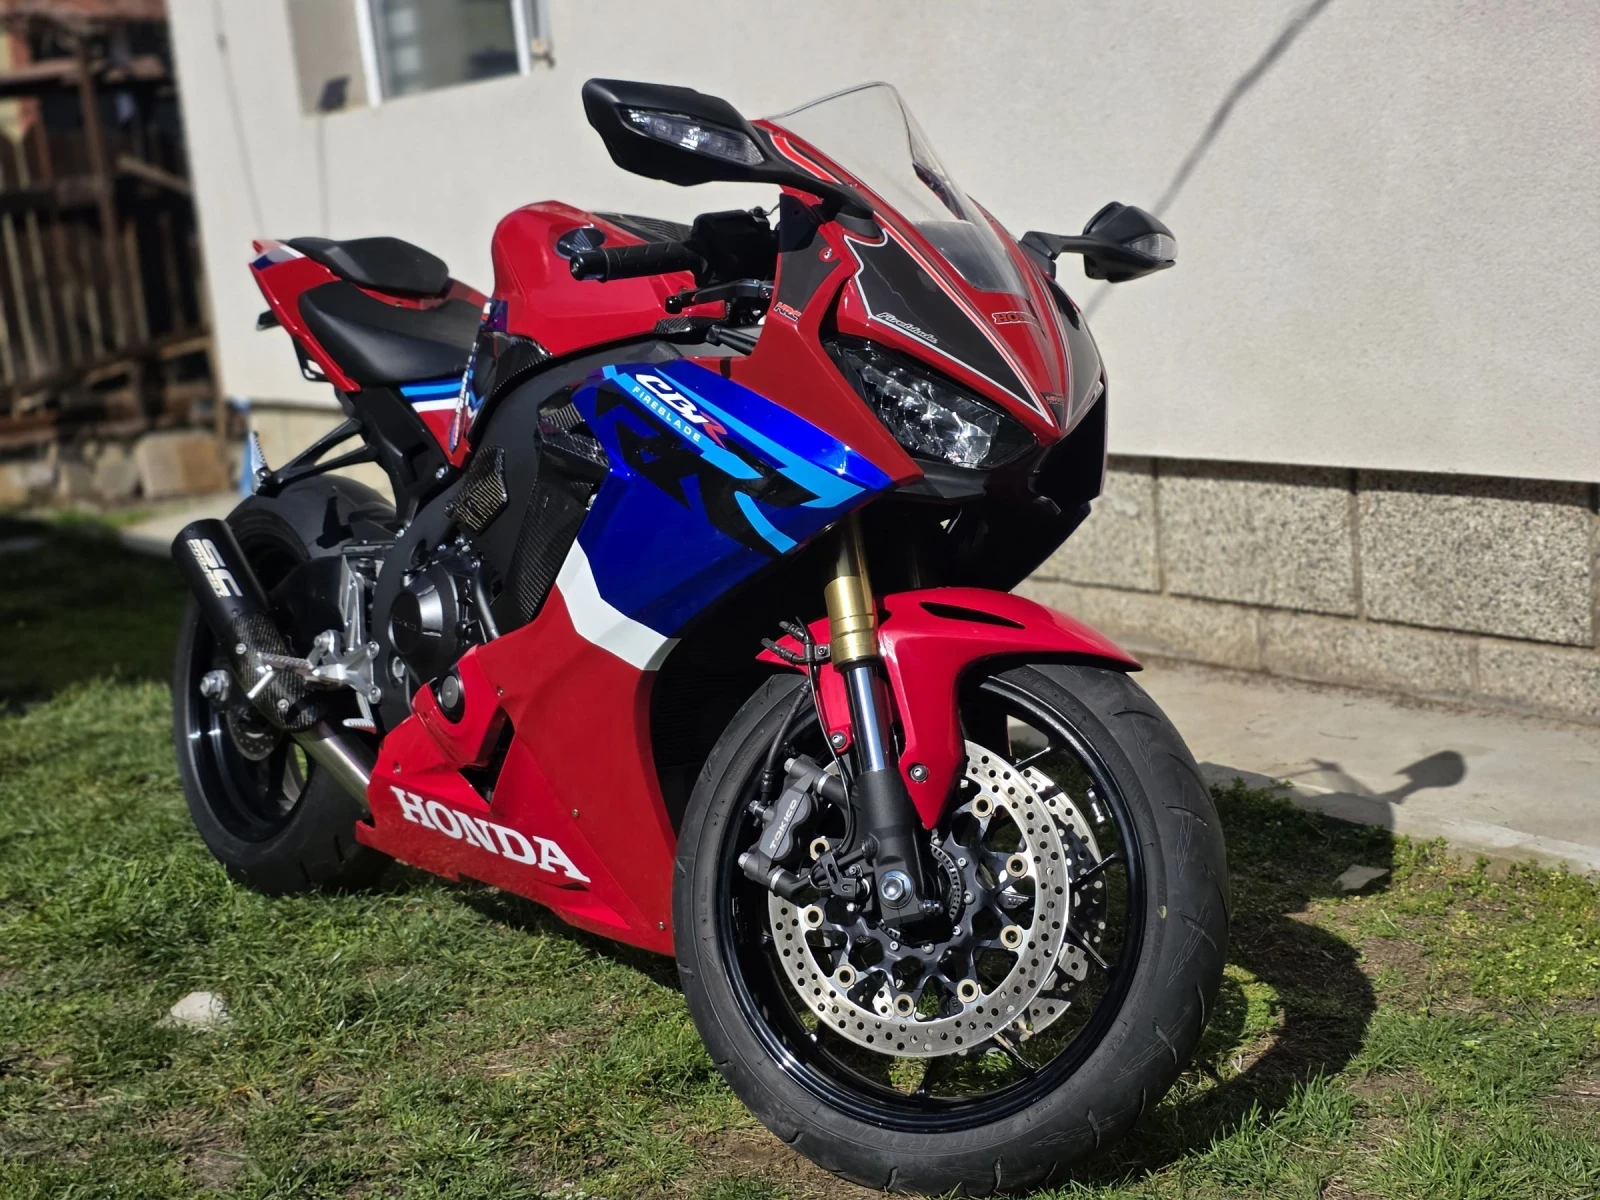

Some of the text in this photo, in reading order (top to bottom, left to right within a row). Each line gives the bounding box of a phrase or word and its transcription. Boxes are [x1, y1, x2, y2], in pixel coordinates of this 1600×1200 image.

[773, 301, 802, 322] HRC
[632, 386, 701, 442] FIREBLADE
[390, 785, 591, 883] HONDA
[770, 799, 798, 850] TOKICO
